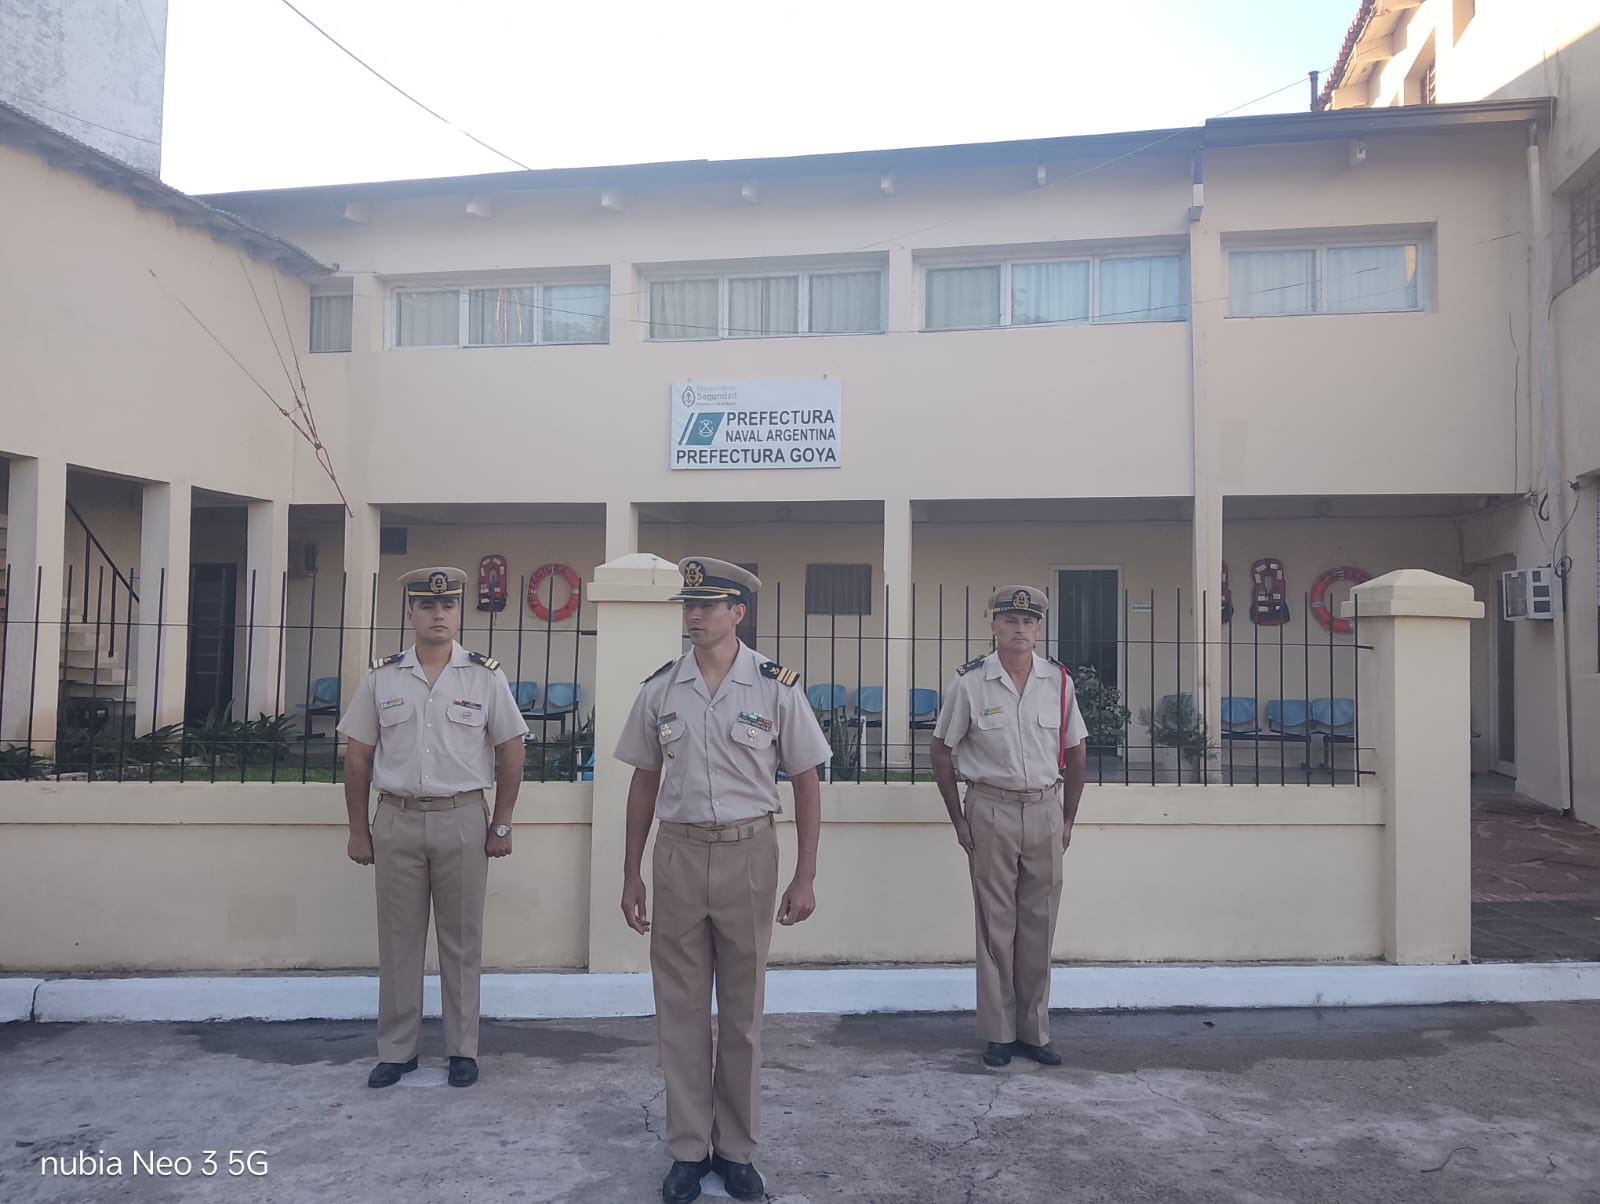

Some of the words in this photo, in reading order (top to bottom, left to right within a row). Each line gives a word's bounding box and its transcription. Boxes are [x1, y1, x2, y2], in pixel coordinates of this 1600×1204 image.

[696, 392, 737, 402] Seguridad
[726, 409, 836, 426] PREFECTURA
[725, 429, 763, 443] NAVAL
[766, 428, 836, 442] ARGENTINA
[676, 448, 785, 464] PREFECTURA
[790, 447, 837, 463] GOYA
